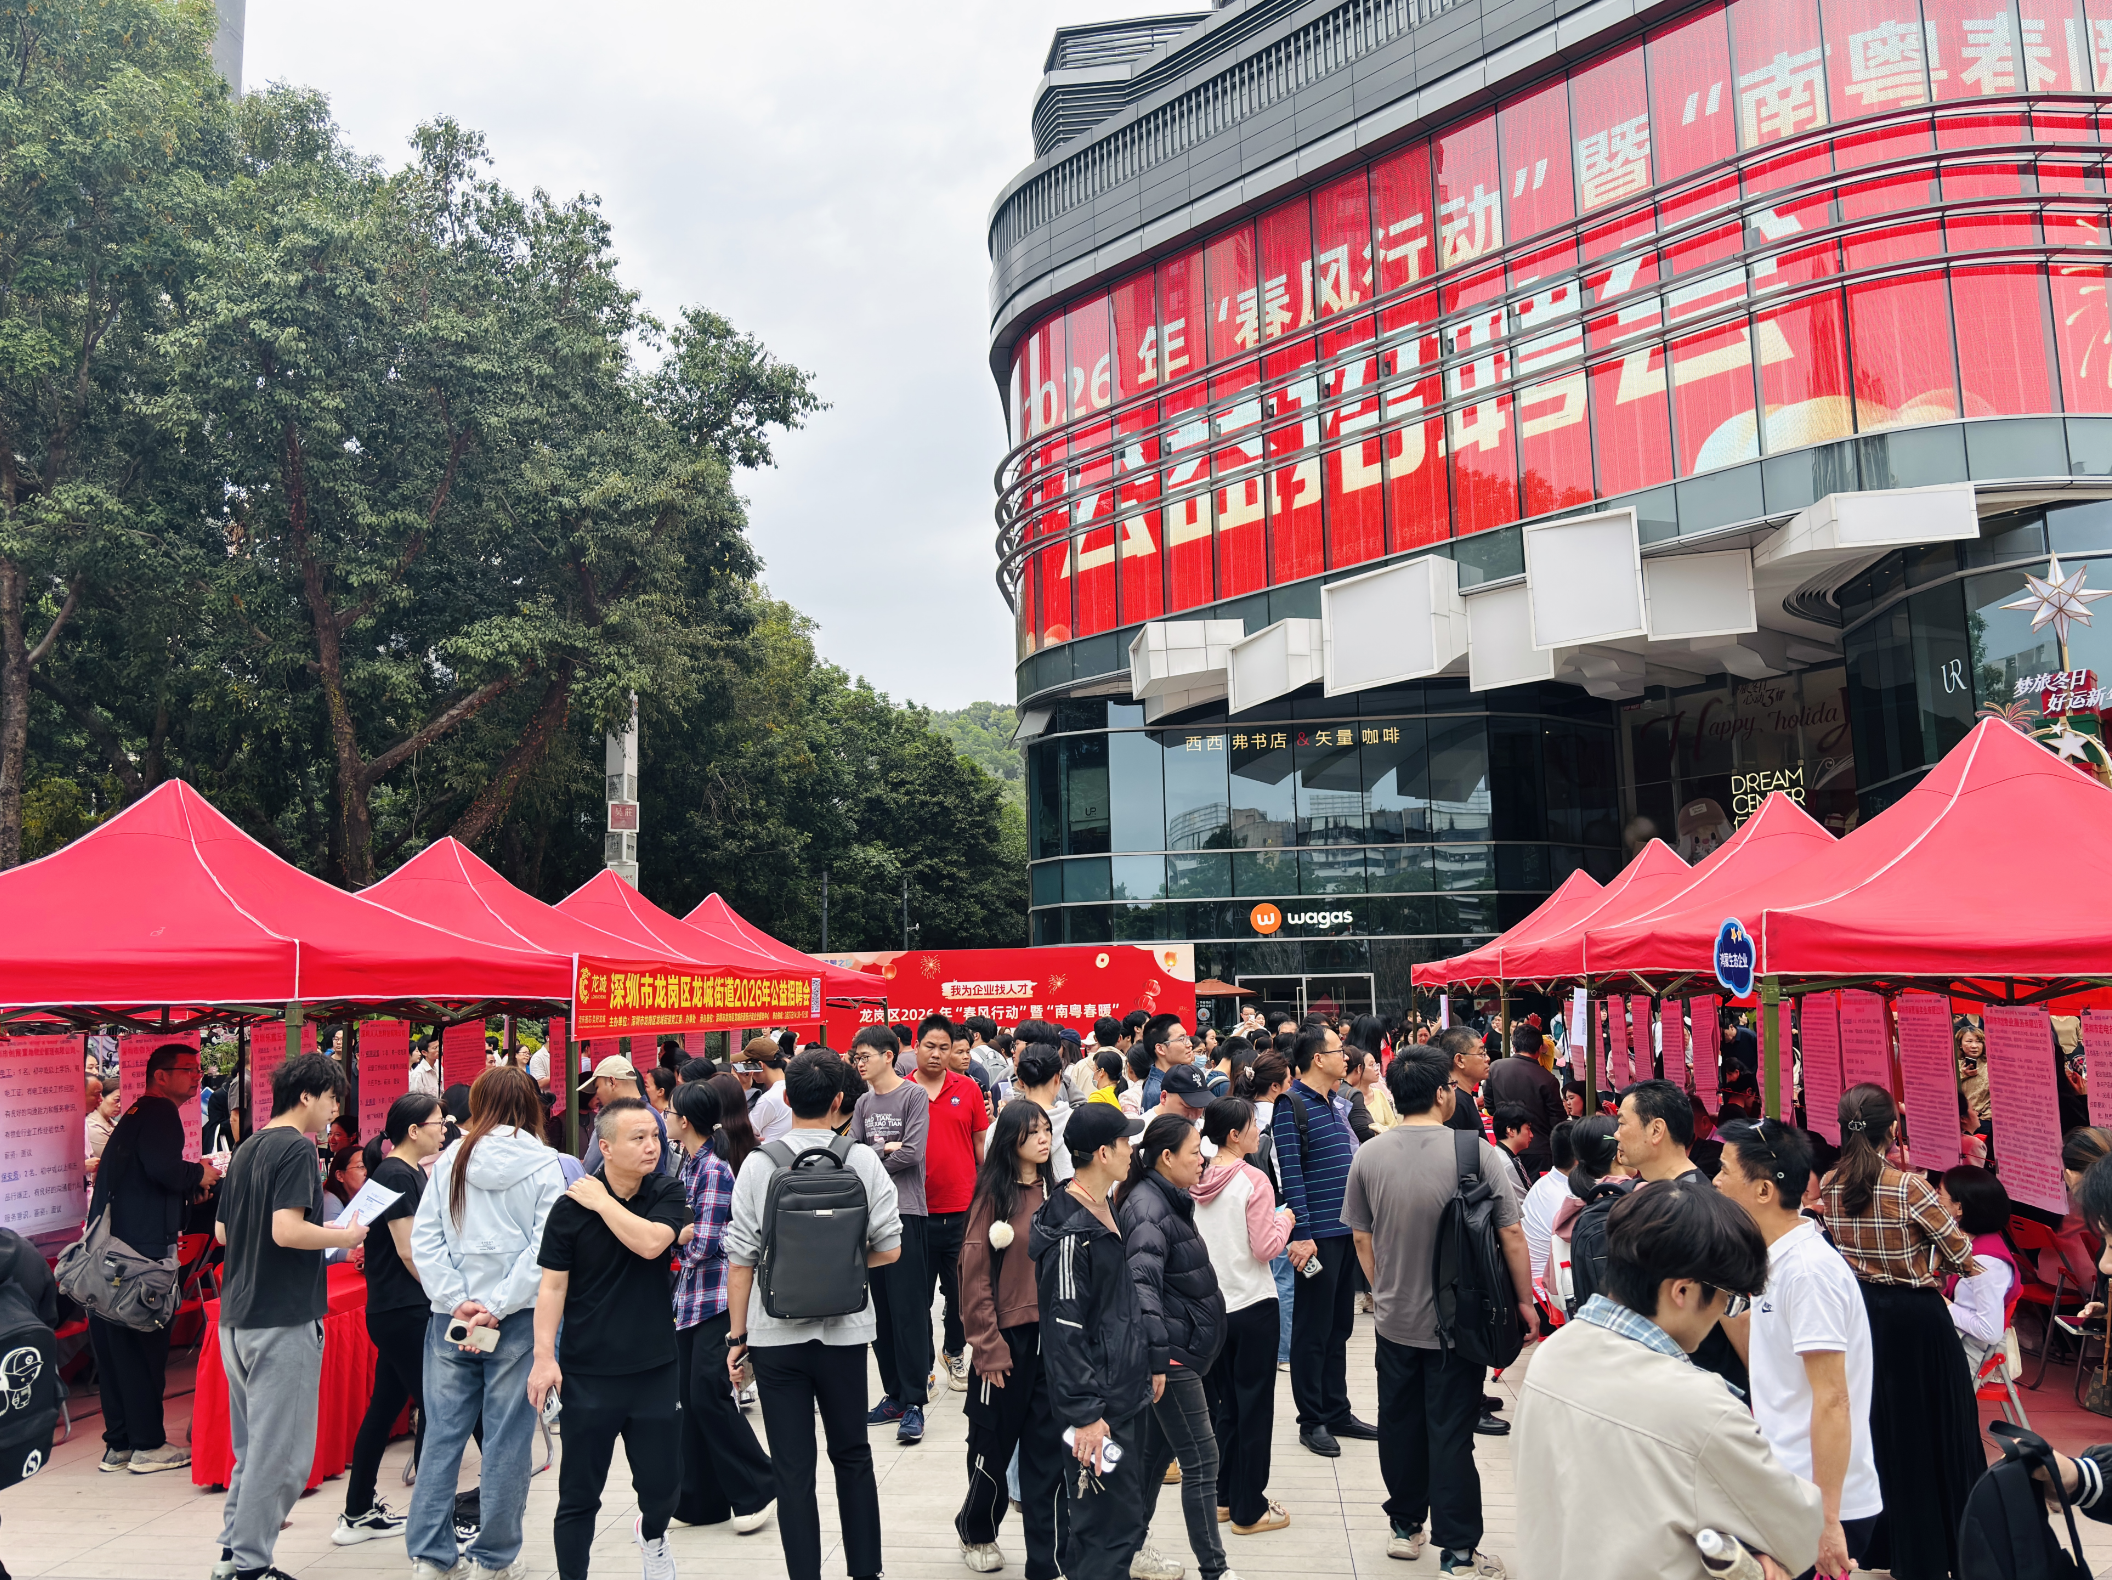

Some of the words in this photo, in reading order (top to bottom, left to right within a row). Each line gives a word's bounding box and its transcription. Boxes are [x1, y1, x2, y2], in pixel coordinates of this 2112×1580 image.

[1060, 192, 1802, 578] 公益招聘会
[1940, 658, 1967, 694] UR
[2013, 668, 2087, 698] 梦旅冬日
[1185, 732, 1287, 752] 西西弗书店
[1297, 731, 1310, 747] &
[1315, 727, 1400, 747] 矢量咖啡
[1640, 697, 1762, 761] Happy
[1731, 766, 1804, 796] DREAM
[1732, 786, 1806, 814] CENER
[1287, 909, 1353, 929] wagas
[1719, 953, 1748, 968] 鸿蒙生态企业
[591, 974, 607, 993] 龙城
[609, 971, 811, 1010] 深圳市龙岗区龙城街道2026年公益招聘会
[950, 983, 1029, 997] 我为企业找人才
